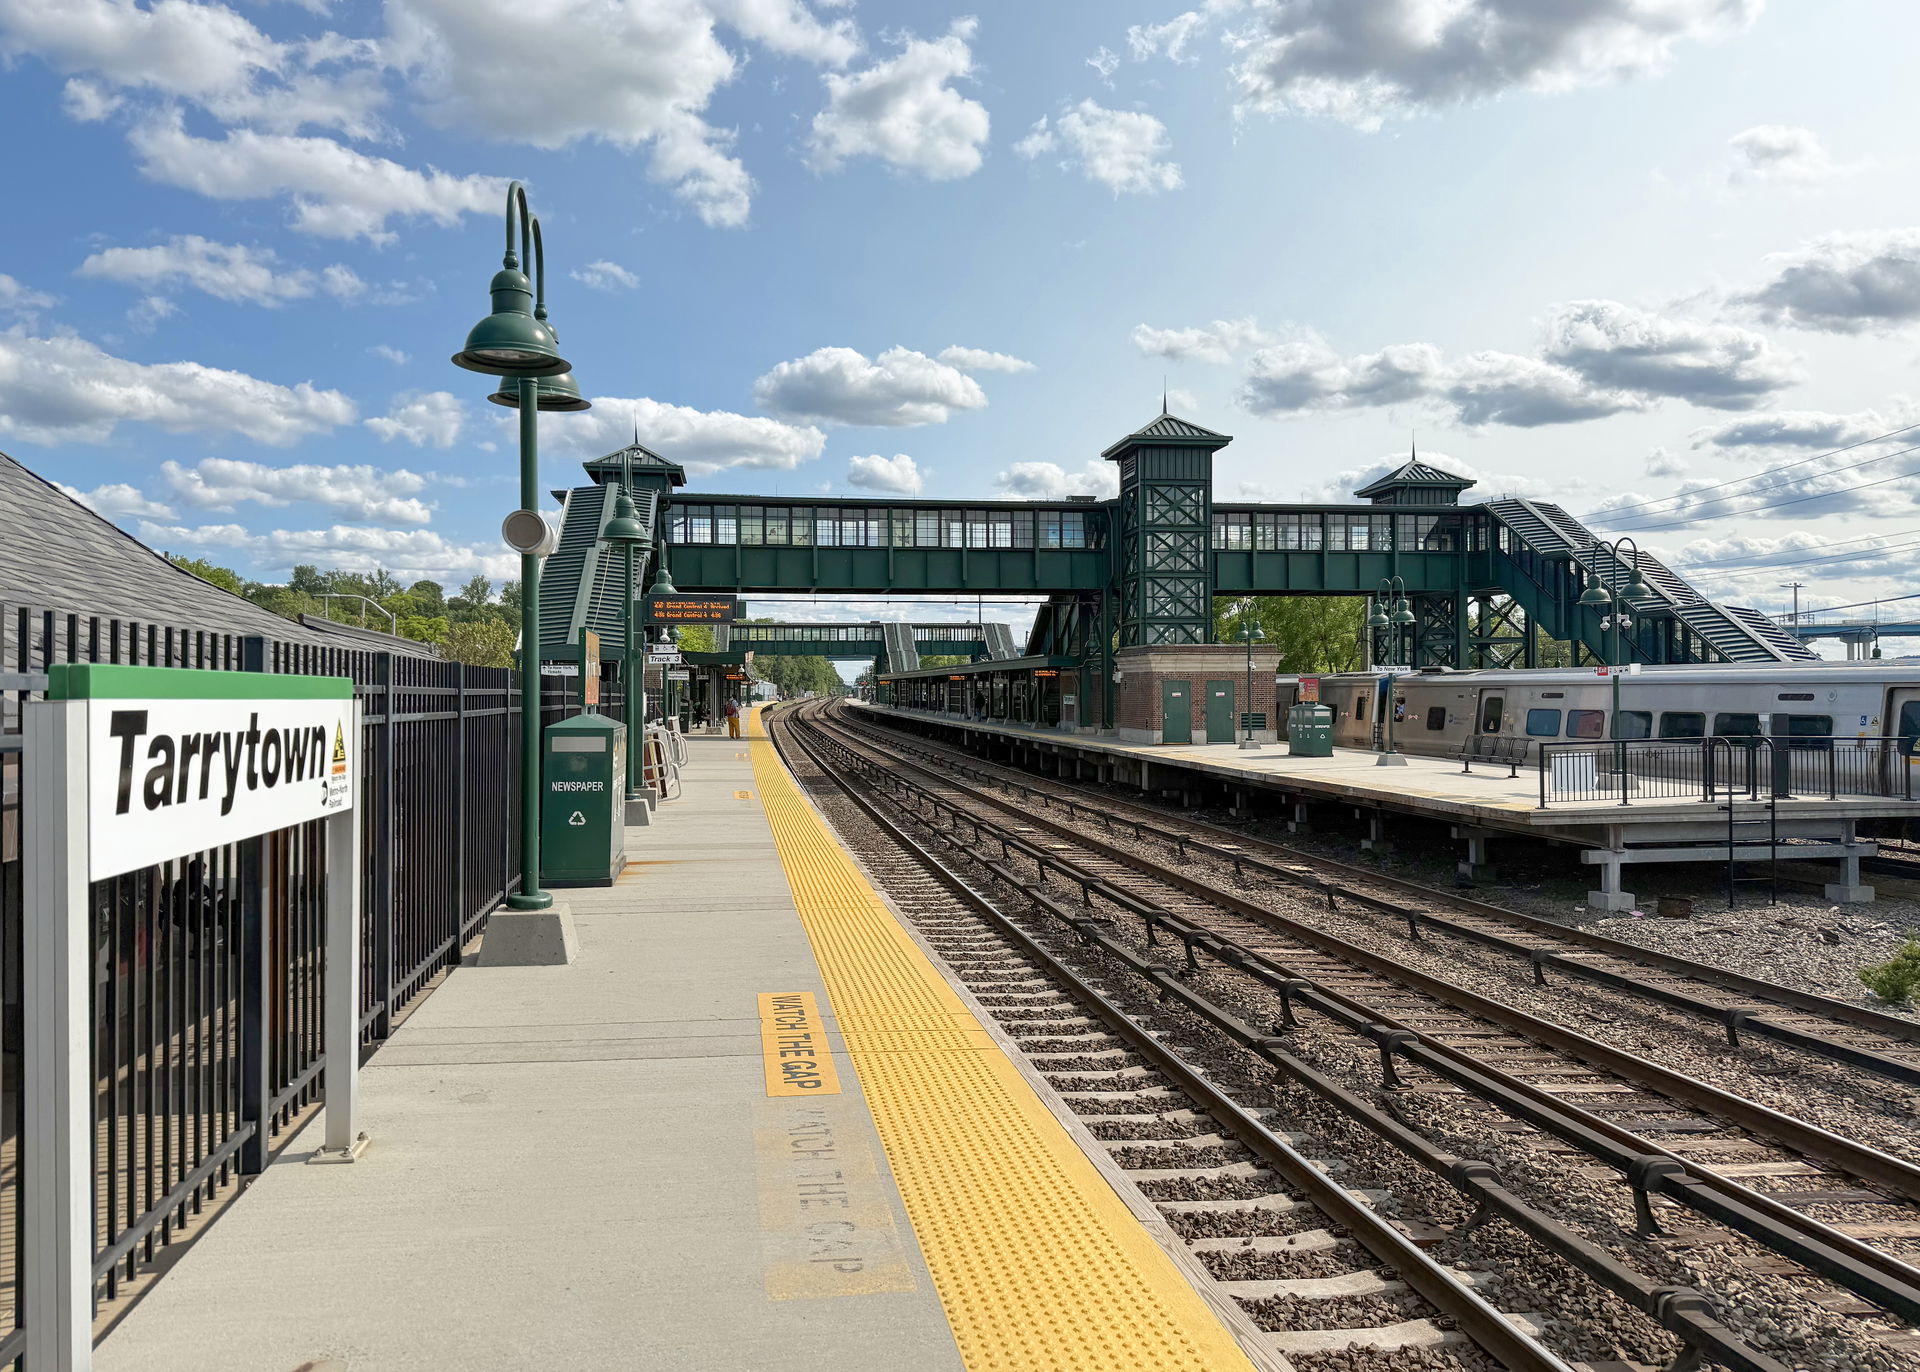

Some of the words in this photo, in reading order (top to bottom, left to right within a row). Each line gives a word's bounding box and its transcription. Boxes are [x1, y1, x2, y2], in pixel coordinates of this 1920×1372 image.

[110, 709, 326, 817] Tarrytown
[551, 781, 604, 792] NEWSPAPER
[772, 994, 808, 1031] WATCH
[778, 1033, 815, 1058] THE
[781, 1061, 822, 1089] GAP
